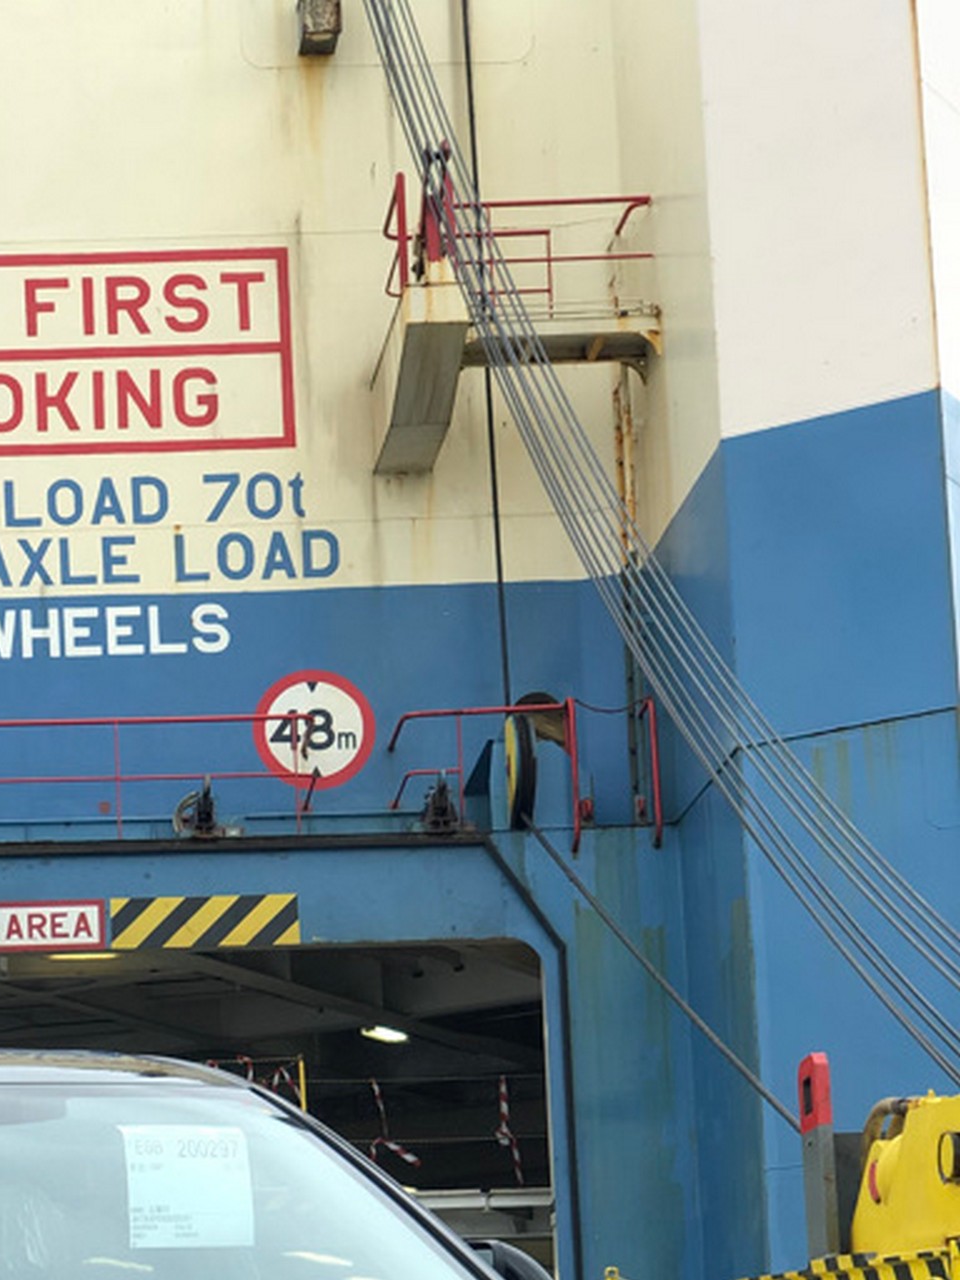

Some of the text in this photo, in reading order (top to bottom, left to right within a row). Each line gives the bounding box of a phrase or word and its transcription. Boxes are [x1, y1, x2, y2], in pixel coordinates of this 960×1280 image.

[25, 273, 264, 336] FIRST
[5, 477, 168, 526] LOAD
[204, 472, 306, 520] 70t
[176, 531, 339, 581] LOAD
[5, 911, 93, 940] AREA
